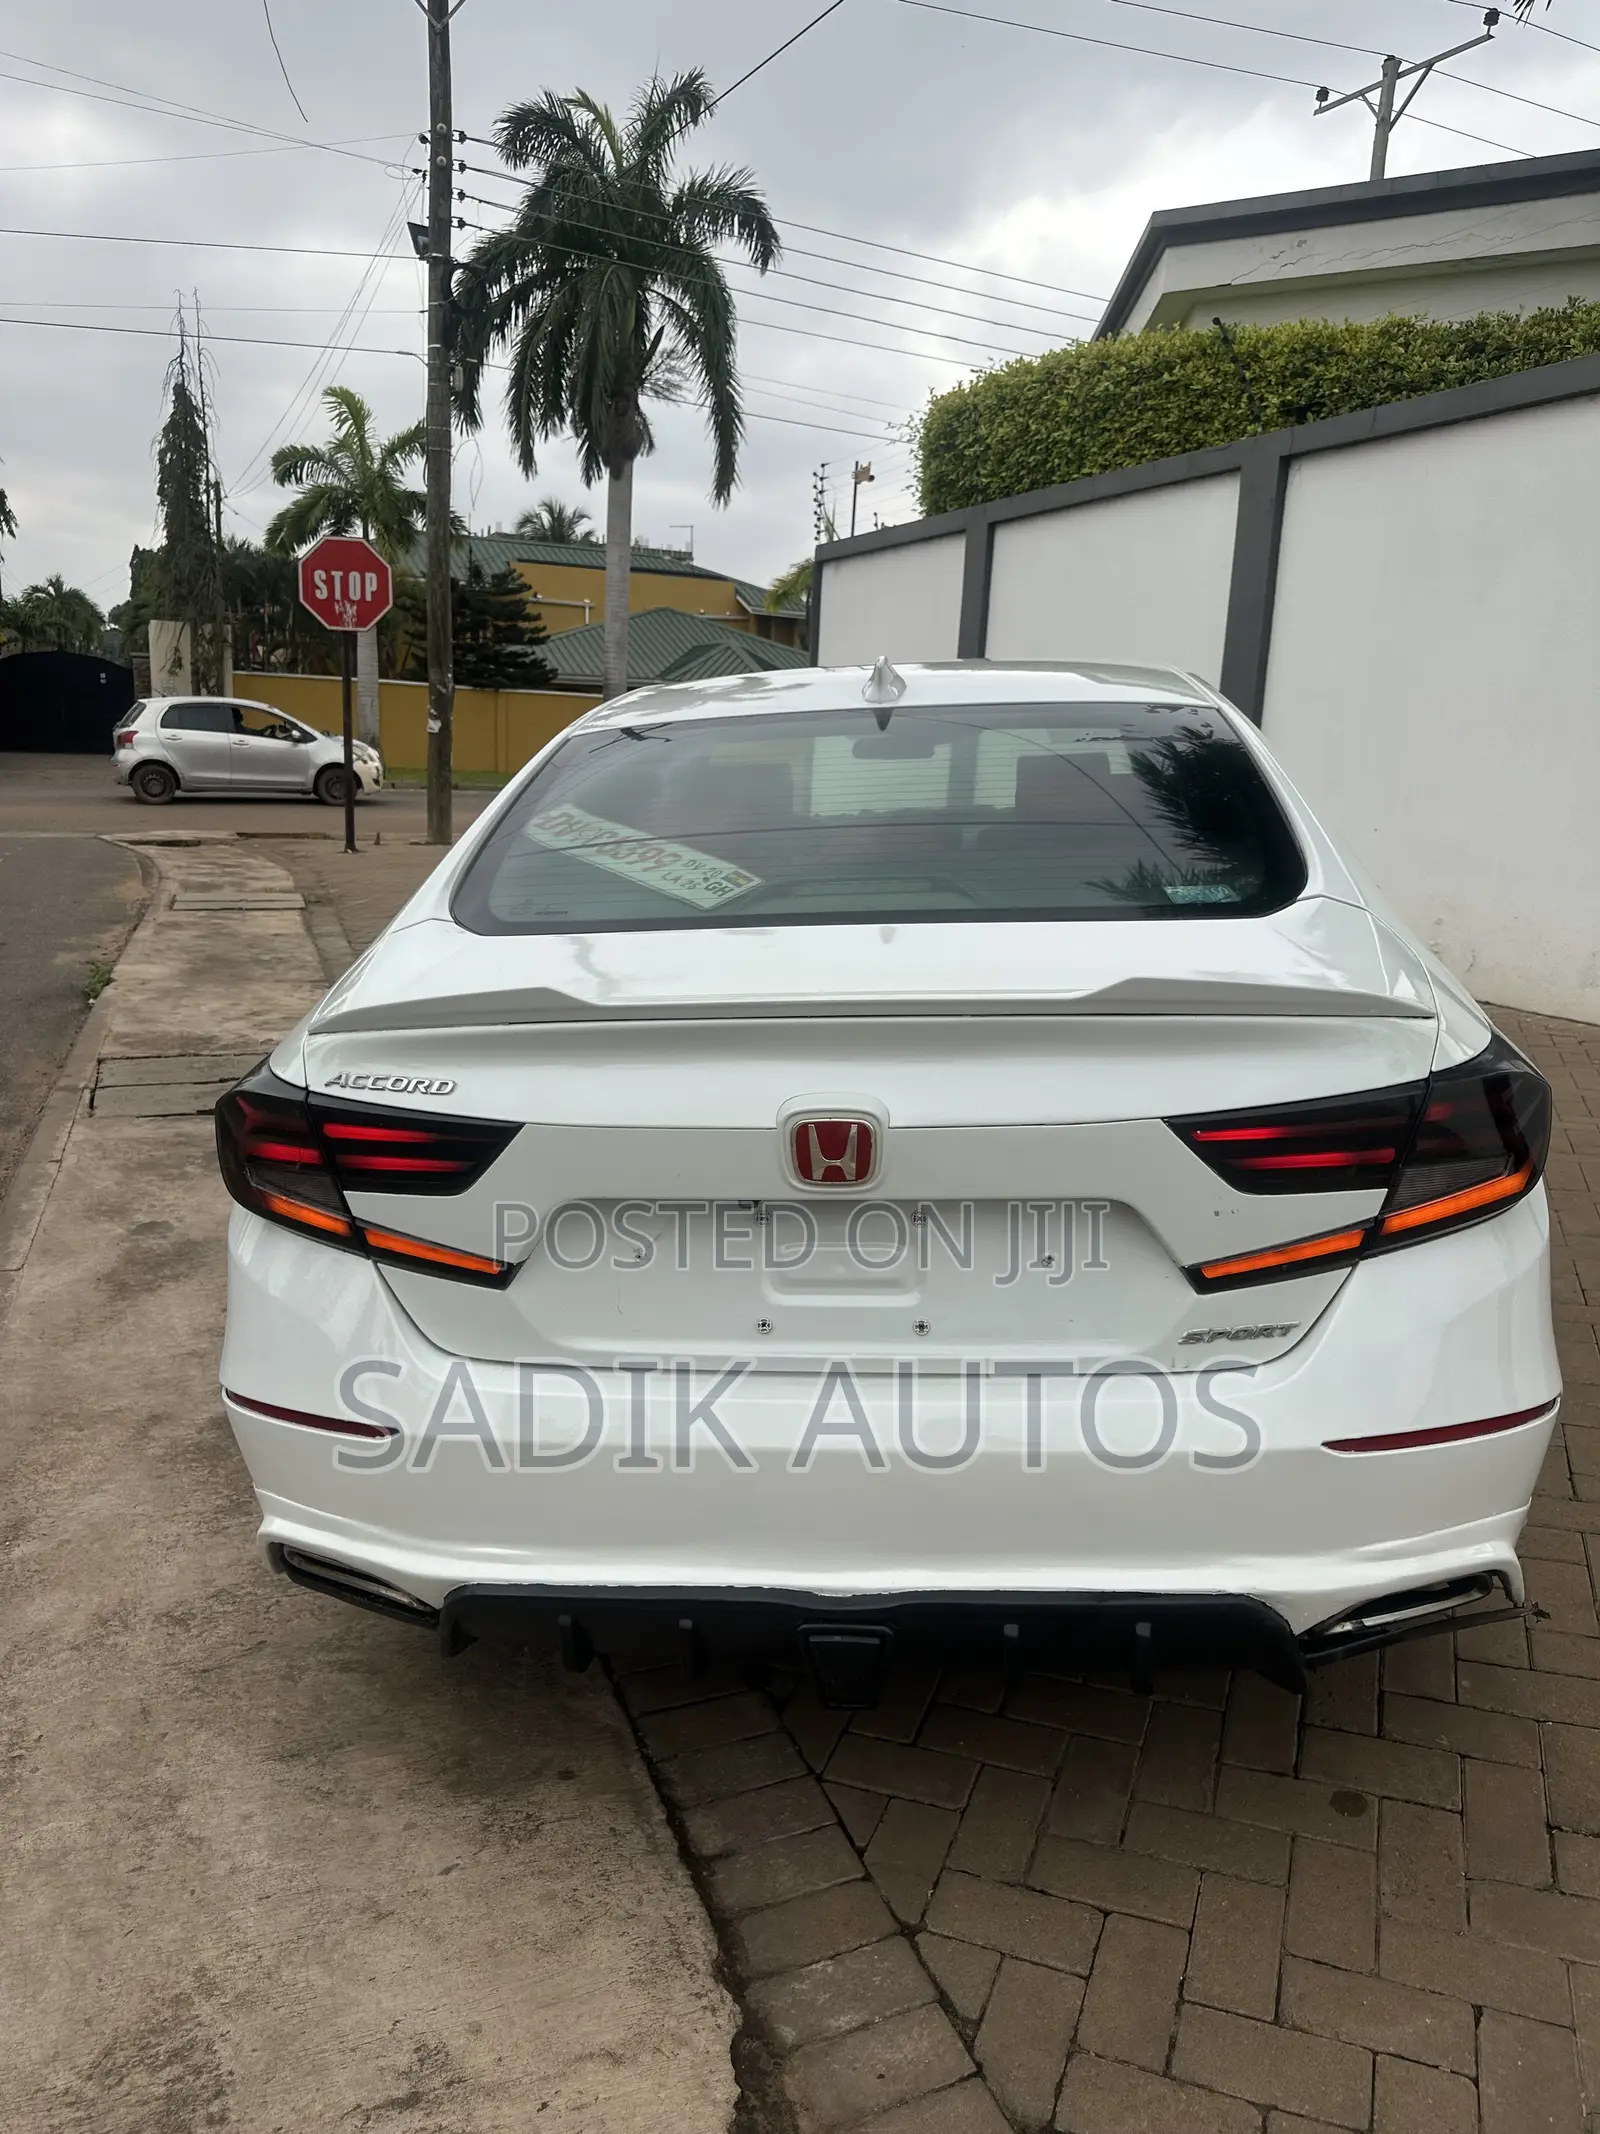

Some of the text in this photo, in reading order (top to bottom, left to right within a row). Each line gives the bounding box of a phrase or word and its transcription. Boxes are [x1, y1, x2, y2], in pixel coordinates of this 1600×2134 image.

[314, 570, 377, 601] STOP
[704, 881, 735, 897] GH
[325, 1072, 457, 1095] ACCORD
[1178, 1321, 1300, 1344] SPORT
